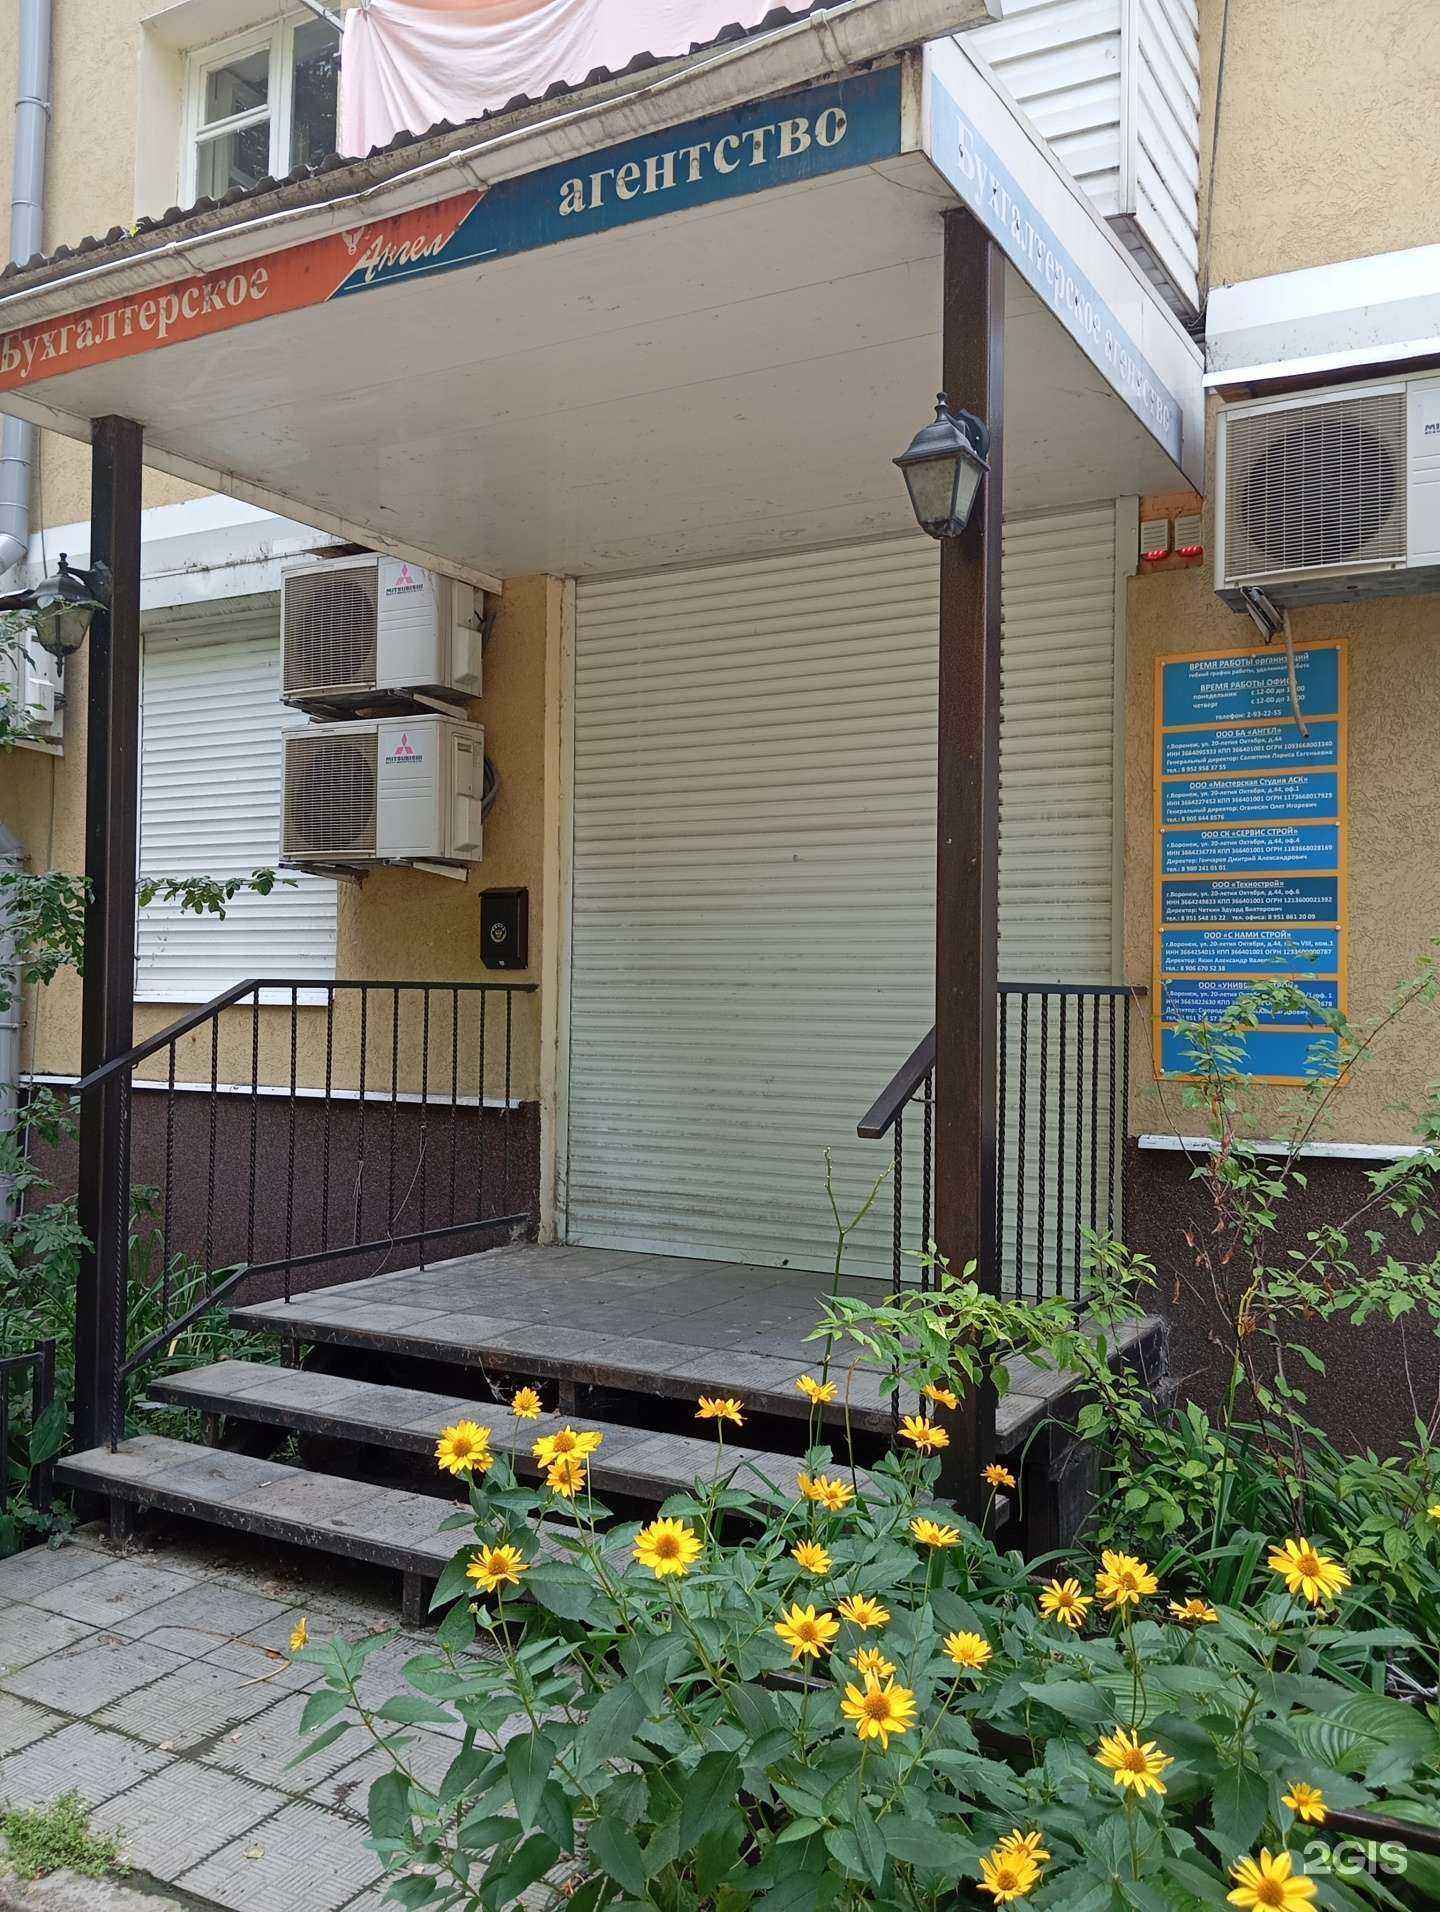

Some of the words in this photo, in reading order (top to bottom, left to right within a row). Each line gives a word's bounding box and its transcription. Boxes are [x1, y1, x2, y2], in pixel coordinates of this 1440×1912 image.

[955, 116, 1102, 345] Бухгалтерское
[0, 266, 269, 378] Бухгалтерское
[558, 107, 848, 216] агентство
[1190, 661, 1218, 670] ВРЕМЯ
[1219, 658, 1253, 668] РАБОТЫ
[1200, 683, 1229, 692] ВРЕМЯ
[1231, 680, 1265, 689] РАБОТЫ
[1215, 713, 1245, 721] телефон:
[1247, 709, 1282, 718] 2-93-22-55
[1216, 730, 1234, 739] ООО
[1235, 729, 1246, 738] БА
[1247, 727, 1282, 737] «АНГЕЛ»
[1167, 750, 1181, 758] ИНН
[1217, 747, 1231, 755] КПП
[1266, 743, 1283, 751] ОГРН
[1189, 781, 1207, 790] ООО
[1208, 778, 1258, 789] «Мастерская
[1259, 777, 1286, 787] Студия
[1287, 776, 1308, 785] АСК»
[1167, 799, 1180, 807] ИНН
[1265, 794, 1283, 802] ОГРН
[1201, 831, 1219, 839] ООО
[1232, 829, 1266, 838] «СЕРВИС
[1267, 827, 1298, 837] СТРОЙ»
[1166, 849, 1181, 857] ИНН
[1217, 847, 1231, 855] КПП
[1227, 855, 1256, 864] Дмитрий
[1212, 881, 1230, 889] ООО
[1231, 879, 1284, 889] «Технострой»
[1166, 898, 1180, 906] ИНН
[1204, 931, 1222, 940] ООО
[1223, 931, 1233, 939] «С
[1234, 931, 1259, 939] НАМИ
[1260, 930, 1292, 939] СТРОЙ»
[1216, 948, 1230, 956] КПП
[1264, 948, 1282, 956] ОГРН
[1214, 957, 1248, 965] Александр
[1198, 981, 1216, 989] ООО
